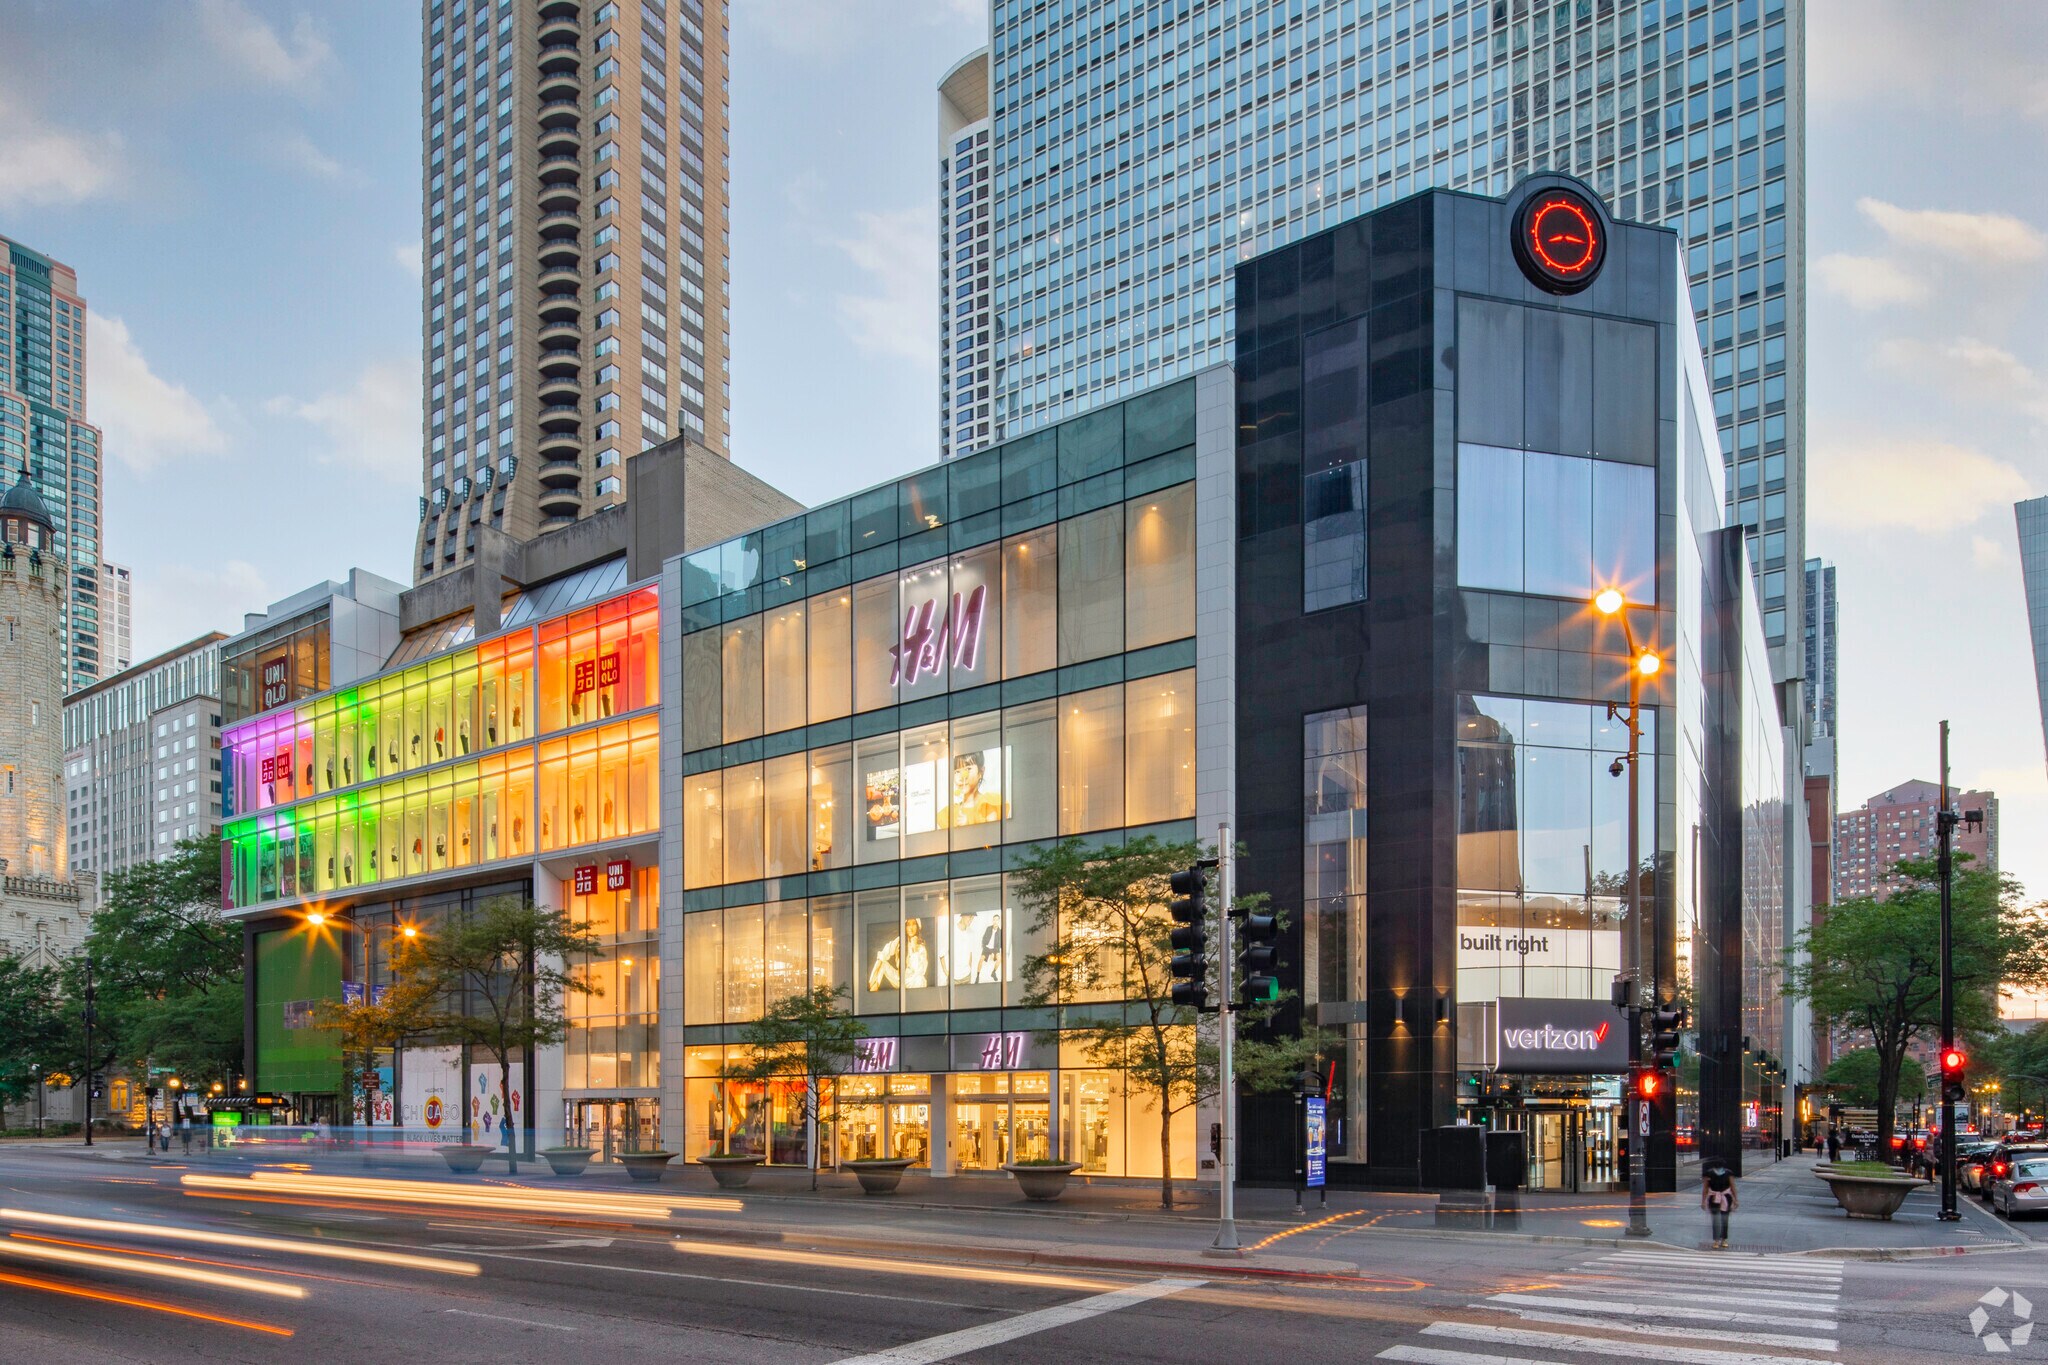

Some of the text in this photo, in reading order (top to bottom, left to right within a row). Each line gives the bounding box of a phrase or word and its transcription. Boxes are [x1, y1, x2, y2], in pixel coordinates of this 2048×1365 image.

[889, 585, 987, 687] H&M
[602, 657, 616, 671] UNI
[265, 663, 285, 686] UNI
[601, 669, 618, 684] QLO
[265, 684, 286, 709] QLO
[278, 766, 289, 778] QLO
[608, 864, 623, 877] UNI
[608, 876, 625, 889] QLO
[1460, 933, 1549, 956] built right
[1504, 1023, 1597, 1051] verizon
[859, 1038, 896, 1072] H&M
[981, 1035, 1023, 1070] H&M
[402, 1104, 460, 1121] CHICAGO
[406, 1134, 463, 1144] BLACK LIVES MATTER
